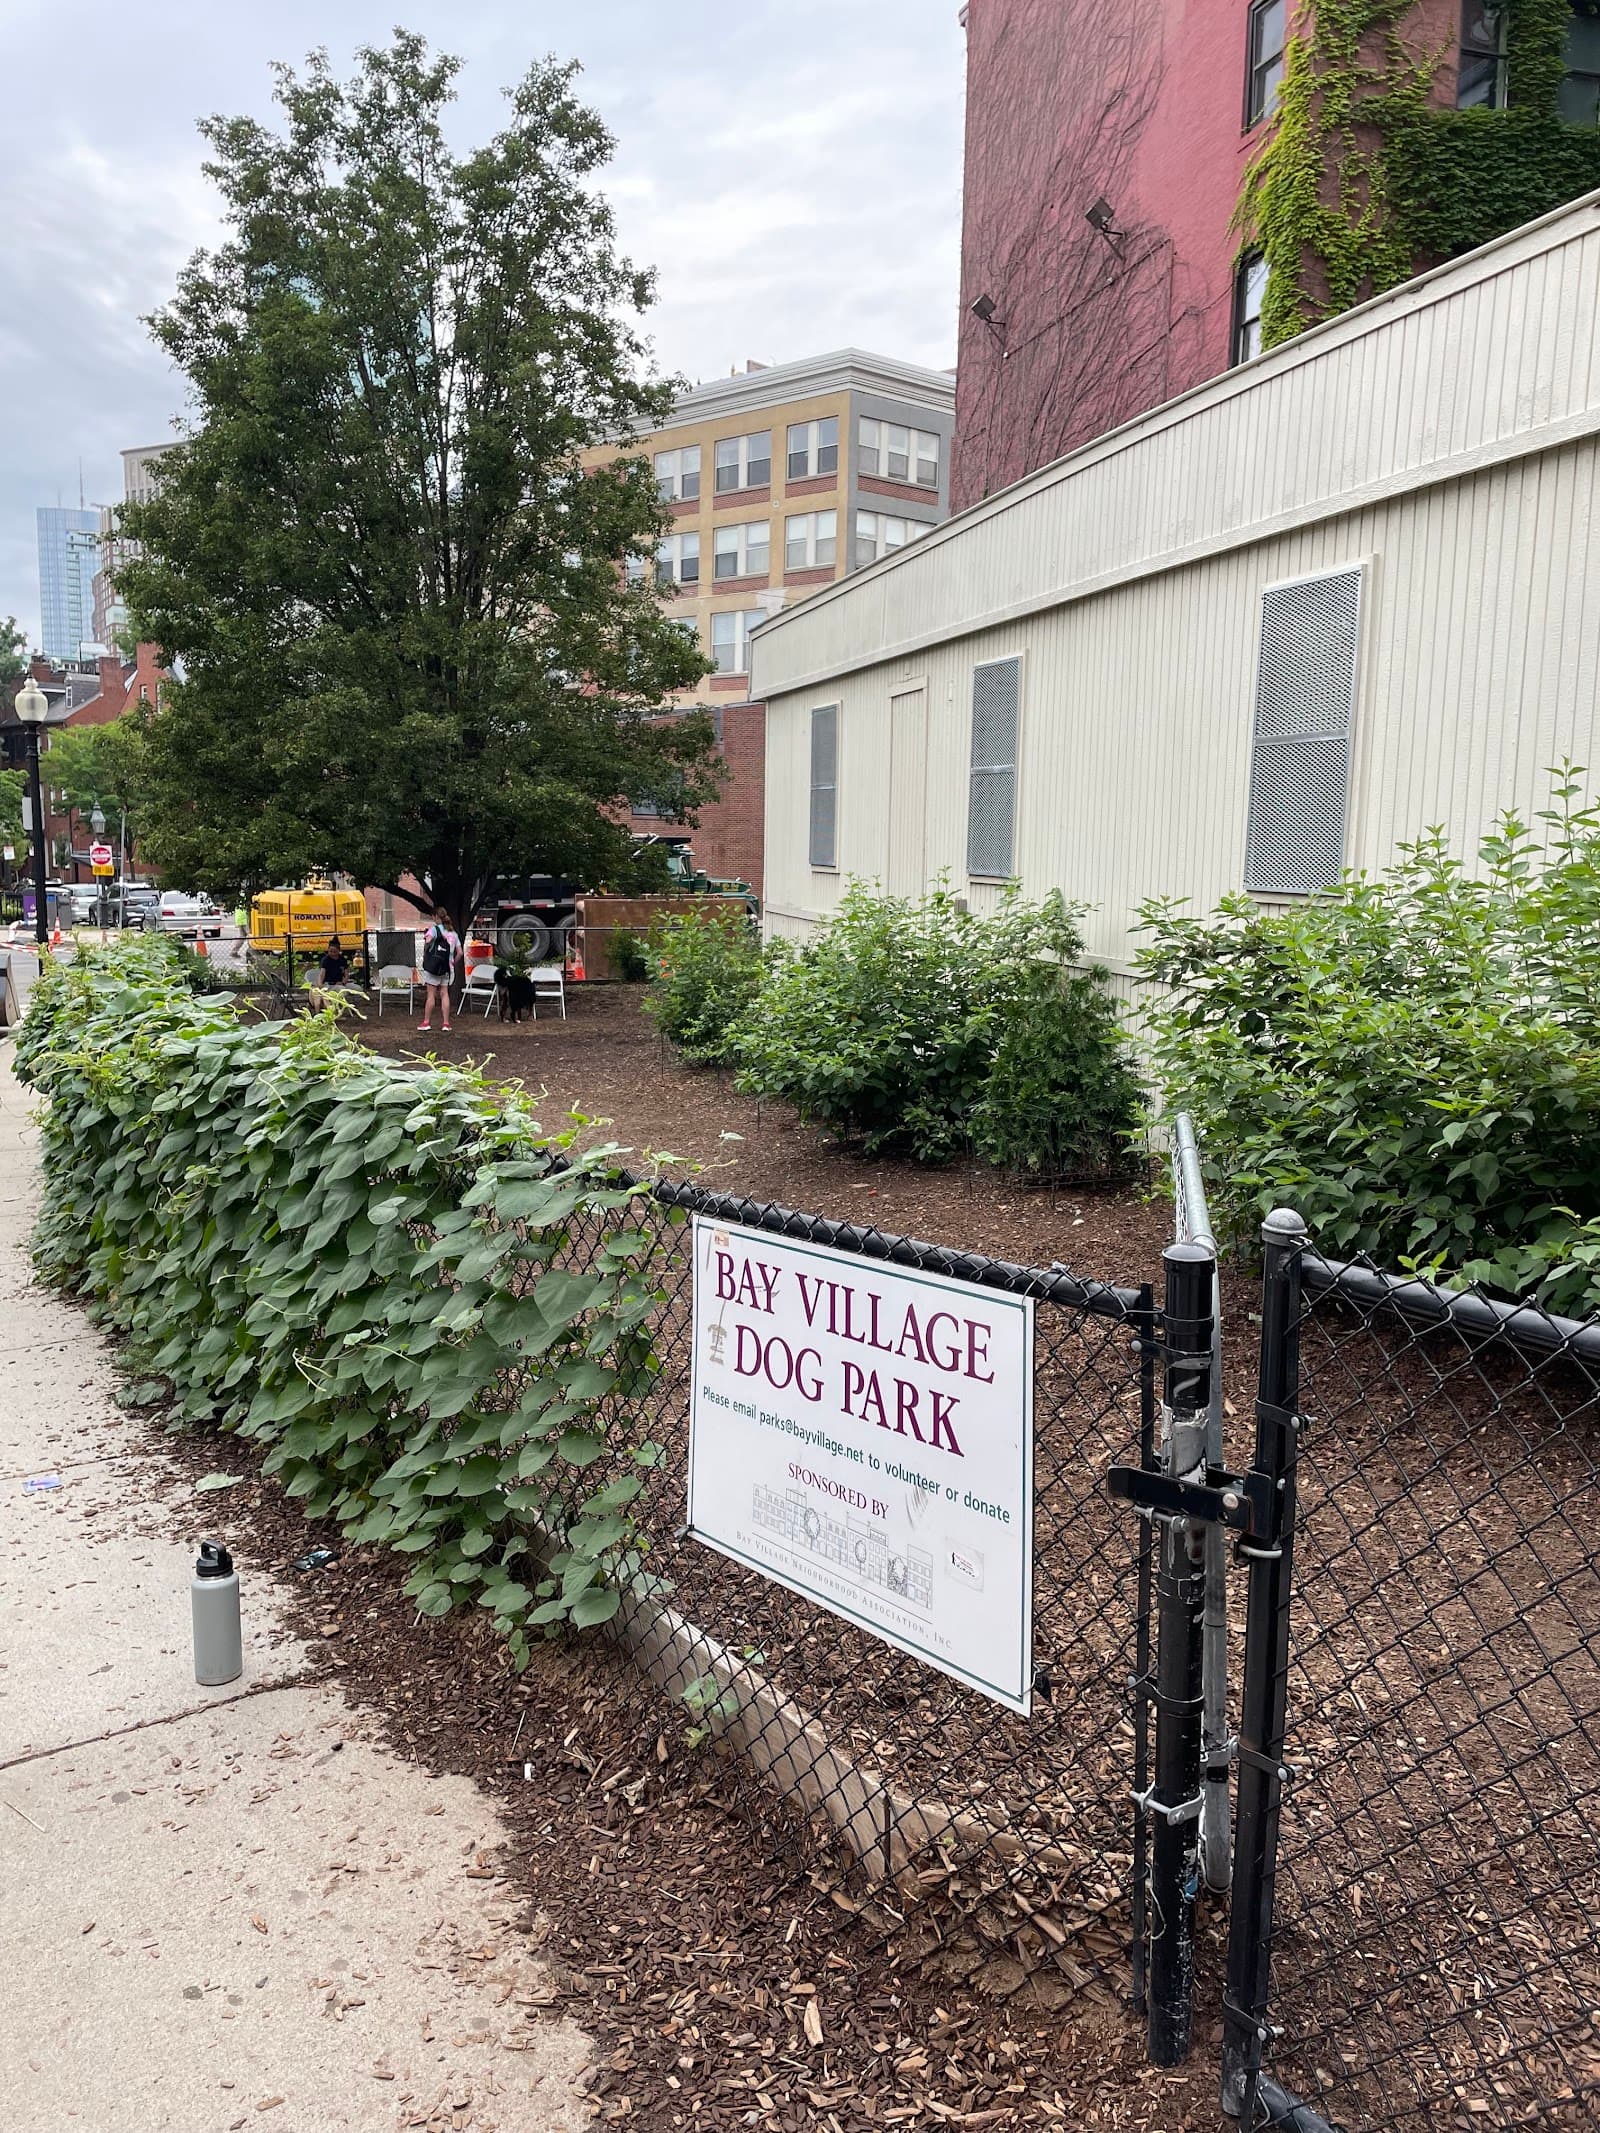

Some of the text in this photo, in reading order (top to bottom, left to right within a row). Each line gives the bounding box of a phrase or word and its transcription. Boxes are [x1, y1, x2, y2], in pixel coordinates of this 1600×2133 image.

[715, 1250, 995, 1384] BAY VILLAGE
[703, 1385, 1010, 1524] Please email parks@bayvillage.net to volunteer or donate
[734, 1324, 965, 1457] DOG PARK
[788, 1462, 889, 1519] SPONSORED BY
